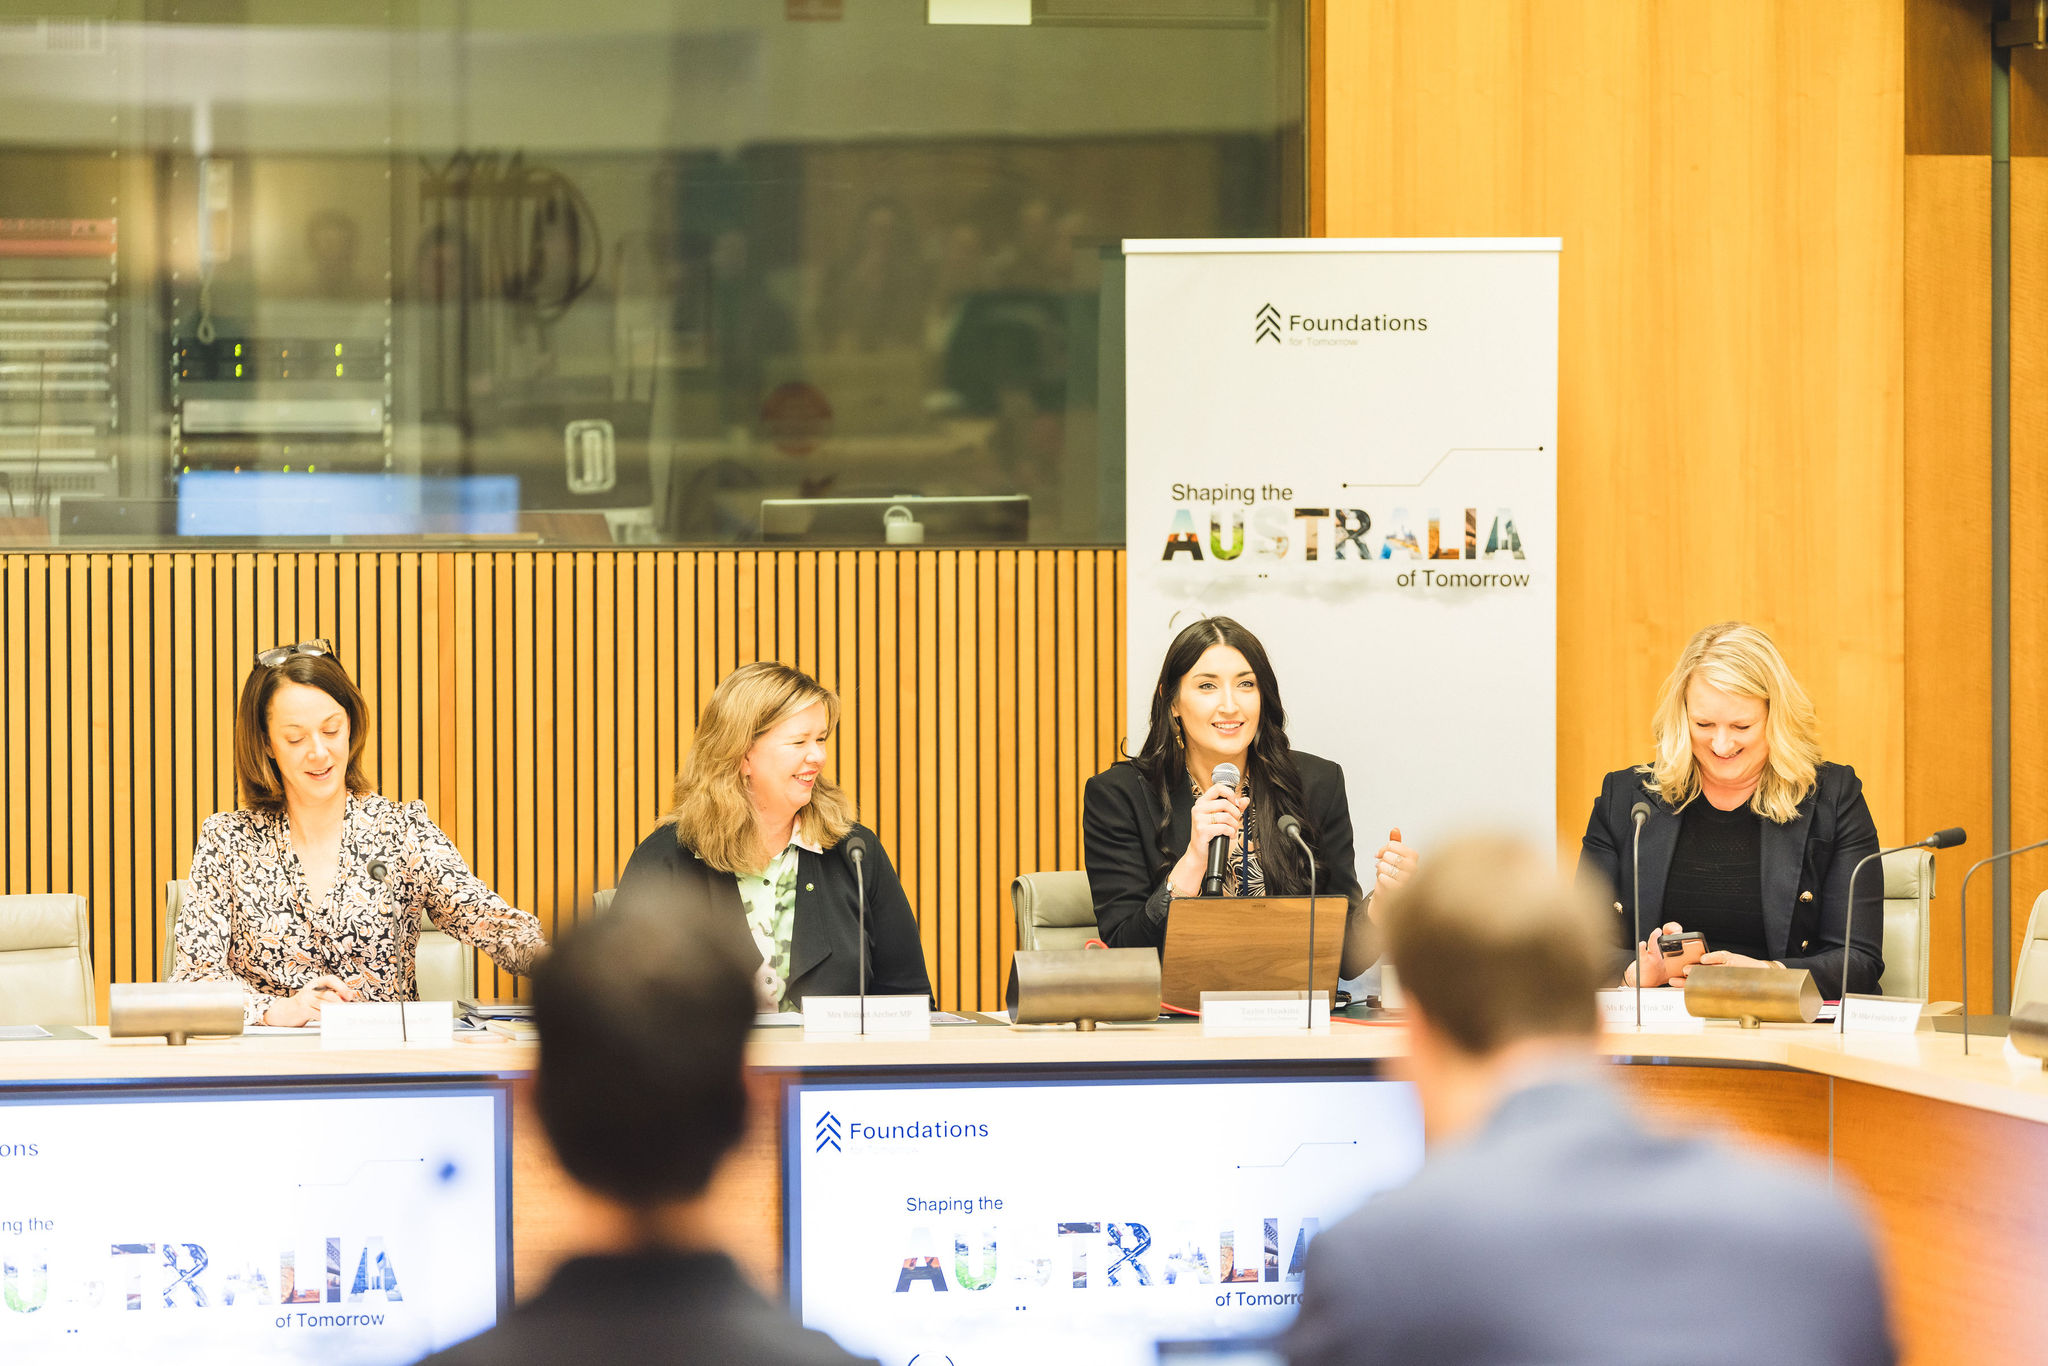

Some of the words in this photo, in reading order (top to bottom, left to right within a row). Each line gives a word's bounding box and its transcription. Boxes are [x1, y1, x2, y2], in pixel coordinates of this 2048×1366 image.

[1289, 313, 1428, 332] Foundations
[1289, 336, 1303, 346] for
[1306, 336, 1359, 346] Tomorrow
[1171, 483, 1255, 505] Shaping
[1261, 483, 1294, 501] the
[1161, 507, 1526, 561] AUSTRALIA
[1397, 569, 1416, 588] of
[1421, 568, 1531, 588] Tomorrow
[850, 1120, 989, 1140] Foundations
[906, 1196, 974, 1215] Shaping
[978, 1195, 1004, 1211] the
[28, 1216, 54, 1232] the
[1215, 1291, 1231, 1307] of
[1235, 1291, 1305, 1307] Tomorro
[276, 1313, 292, 1329] of
[296, 1312, 385, 1328] Tomorrow
